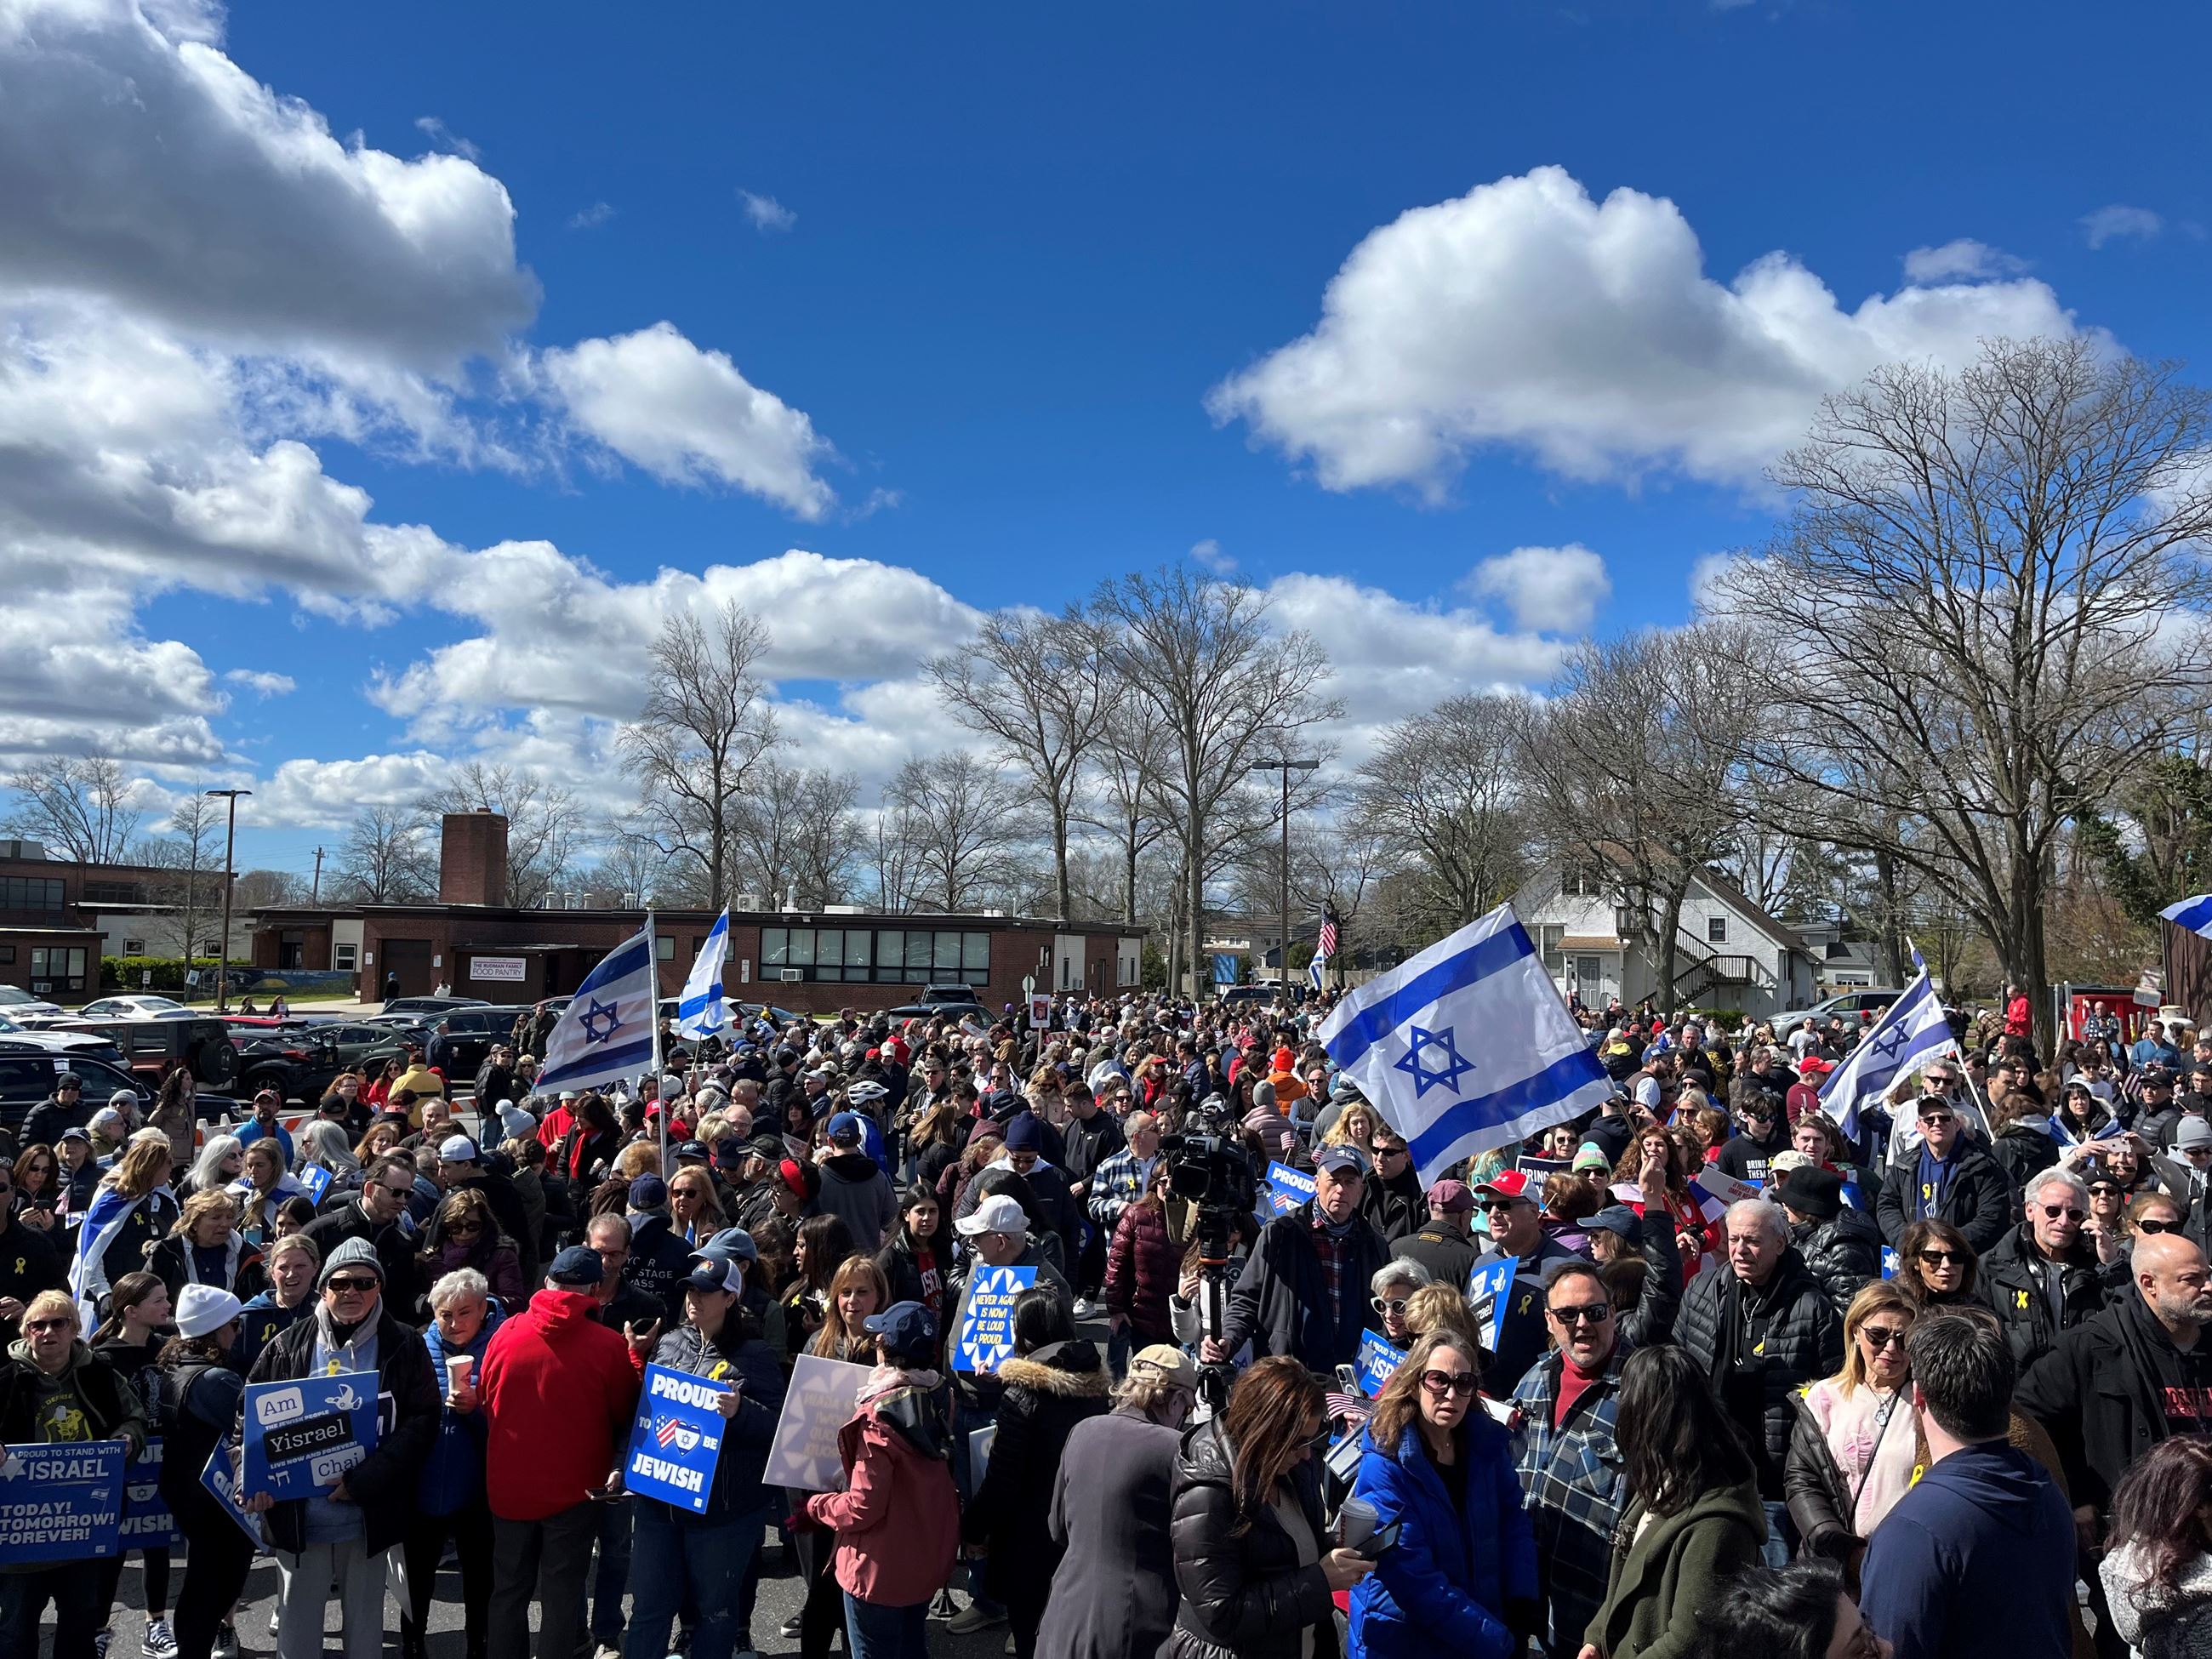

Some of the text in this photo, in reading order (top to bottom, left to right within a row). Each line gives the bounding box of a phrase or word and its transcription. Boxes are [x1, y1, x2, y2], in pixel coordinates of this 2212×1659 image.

[494, 968, 522, 977] PANTRY
[1746, 1159, 1766, 1170] BRING
[1271, 1166, 1316, 1194] PROUD
[1747, 1169, 1767, 1179] THEM
[630, 1278, 654, 1288] ASS
[975, 1294, 998, 1305] NEVER
[980, 1308, 1008, 1318] IS NOW!
[976, 1320, 1006, 1331] BE LOUD
[972, 1333, 1003, 1345] & PROUD!
[1372, 1341, 1389, 1356] PROUD
[1388, 1350, 1397, 1360] TO
[650, 1373, 721, 1414] PROUD
[263, 1398, 298, 1417] Am
[265, 1409, 330, 1431] THE JEWISH PEOPLE
[638, 1416, 652, 1430] TO
[269, 1418, 346, 1453] Yisrael
[702, 1435, 719, 1451] BE
[17, 1445, 121, 1459] PROUD TO STAND WITH
[270, 1440, 358, 1469] LIVE NOW AND FOREVER!
[28, 1458, 109, 1481] ISRAEL
[318, 1451, 359, 1477] Chai
[631, 1452, 704, 1493] JEWISH
[267, 1469, 291, 1487] חי
[0, 1501, 72, 1518] TODAY!
[0, 1512, 115, 1531] TOMORROW!
[117, 1513, 174, 1535] WISH
[0, 1527, 90, 1546] FOREVER!
